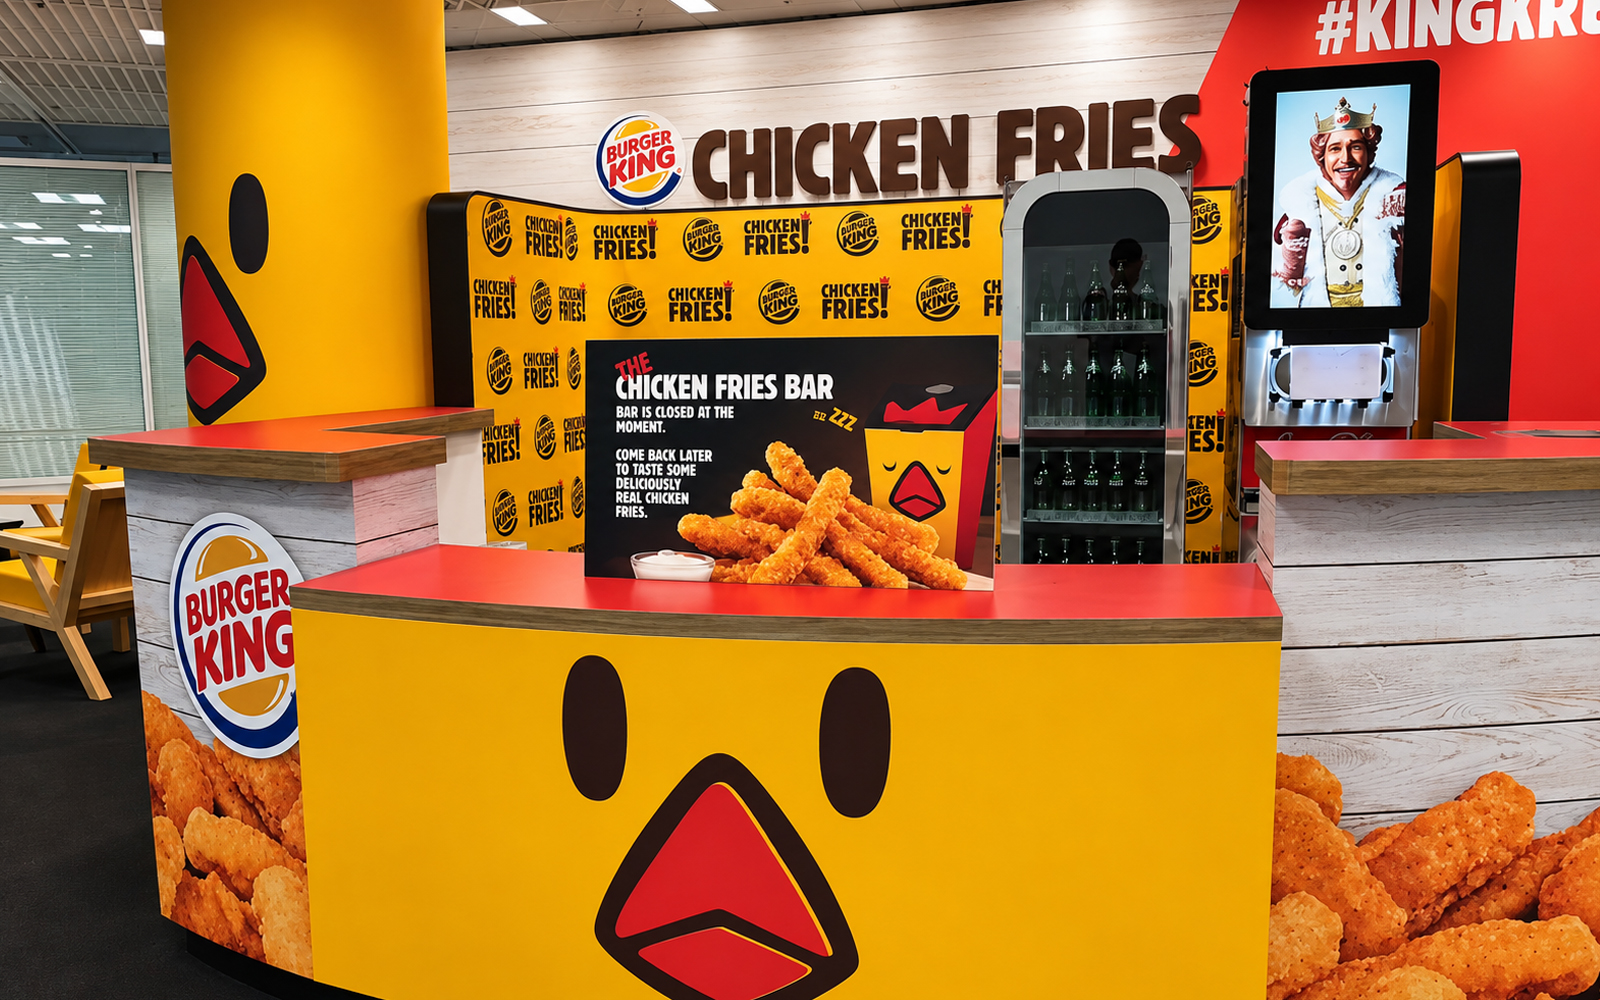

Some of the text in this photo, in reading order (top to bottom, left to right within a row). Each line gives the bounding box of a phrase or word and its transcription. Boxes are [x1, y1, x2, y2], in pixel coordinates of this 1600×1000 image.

[606, 130, 672, 165] BURGER
[692, 94, 1201, 200] CHICKEN FRIES
[609, 145, 675, 188] KING
[744, 218, 800, 235] CHICKEN
[901, 211, 961, 228] CHICKEN
[1193, 211, 1221, 230] ING
[593, 225, 647, 239] CHICKEN
[842, 227, 877, 250] KING
[668, 286, 723, 301] CHICKEN
[821, 282, 879, 298] CHICKEN
[922, 293, 959, 315] KING
[614, 351, 653, 381] THE
[1189, 355, 1216, 374] ING
[615, 374, 833, 400] CHICKEN FRIES BAR
[616, 406, 734, 418] BAR IS CLOSED AT THE
[482, 424, 514, 441] HICKEN
[616, 421, 666, 433] MOMENT.
[616, 449, 713, 462] COME BACK LATER
[616, 463, 696, 476] TO TASTE SOME
[616, 477, 681, 490] DELICIOUSLY
[616, 491, 689, 504] REAL CHICKEN
[1186, 493, 1212, 512] ING
[616, 506, 648, 518] FRIES.
[185, 569, 290, 636] BURGER
[194, 610, 294, 692] KING
